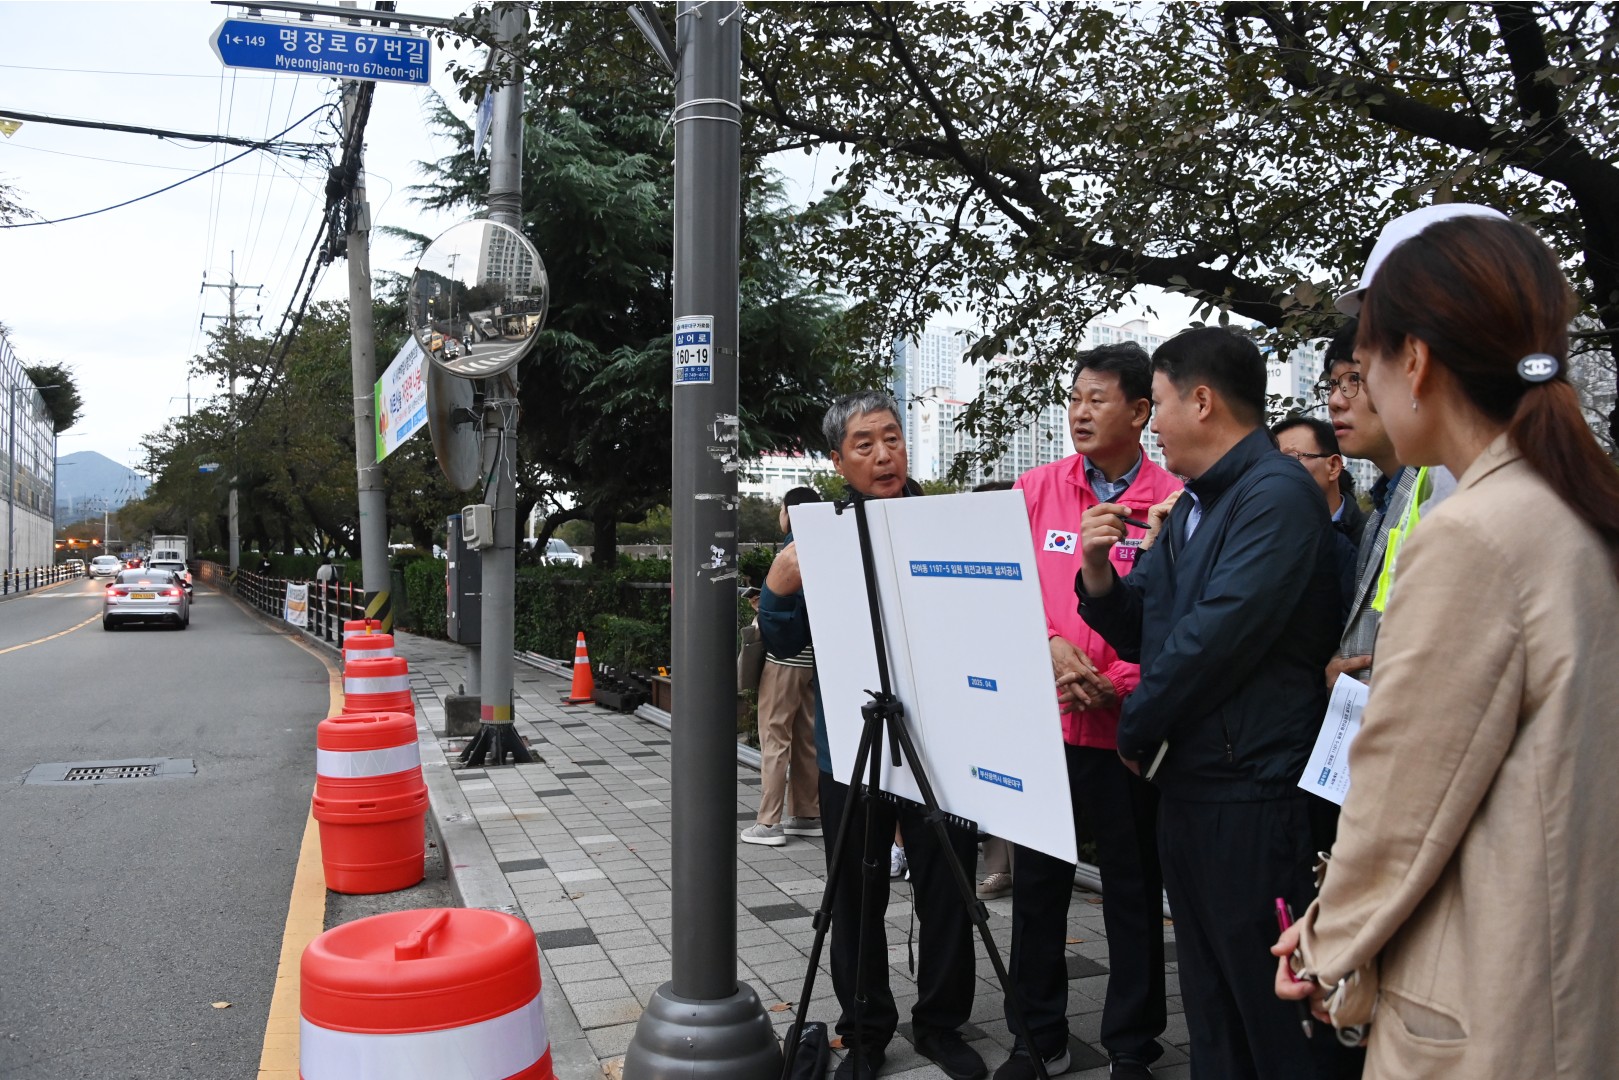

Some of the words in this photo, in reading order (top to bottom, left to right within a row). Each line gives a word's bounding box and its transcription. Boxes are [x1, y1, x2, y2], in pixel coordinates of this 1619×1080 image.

[244, 35, 266, 46] 149
[276, 54, 360, 73] Myeongjang-ro
[363, 62, 424, 80] 67beon-gil
[676, 348, 708, 364] 160-19
[911, 564, 928, 574] 반여동
[929, 564, 950, 574] 1197-5
[950, 564, 962, 574] 일원
[964, 565, 993, 576] 회전교차로
[994, 566, 1020, 576] 설치공사
